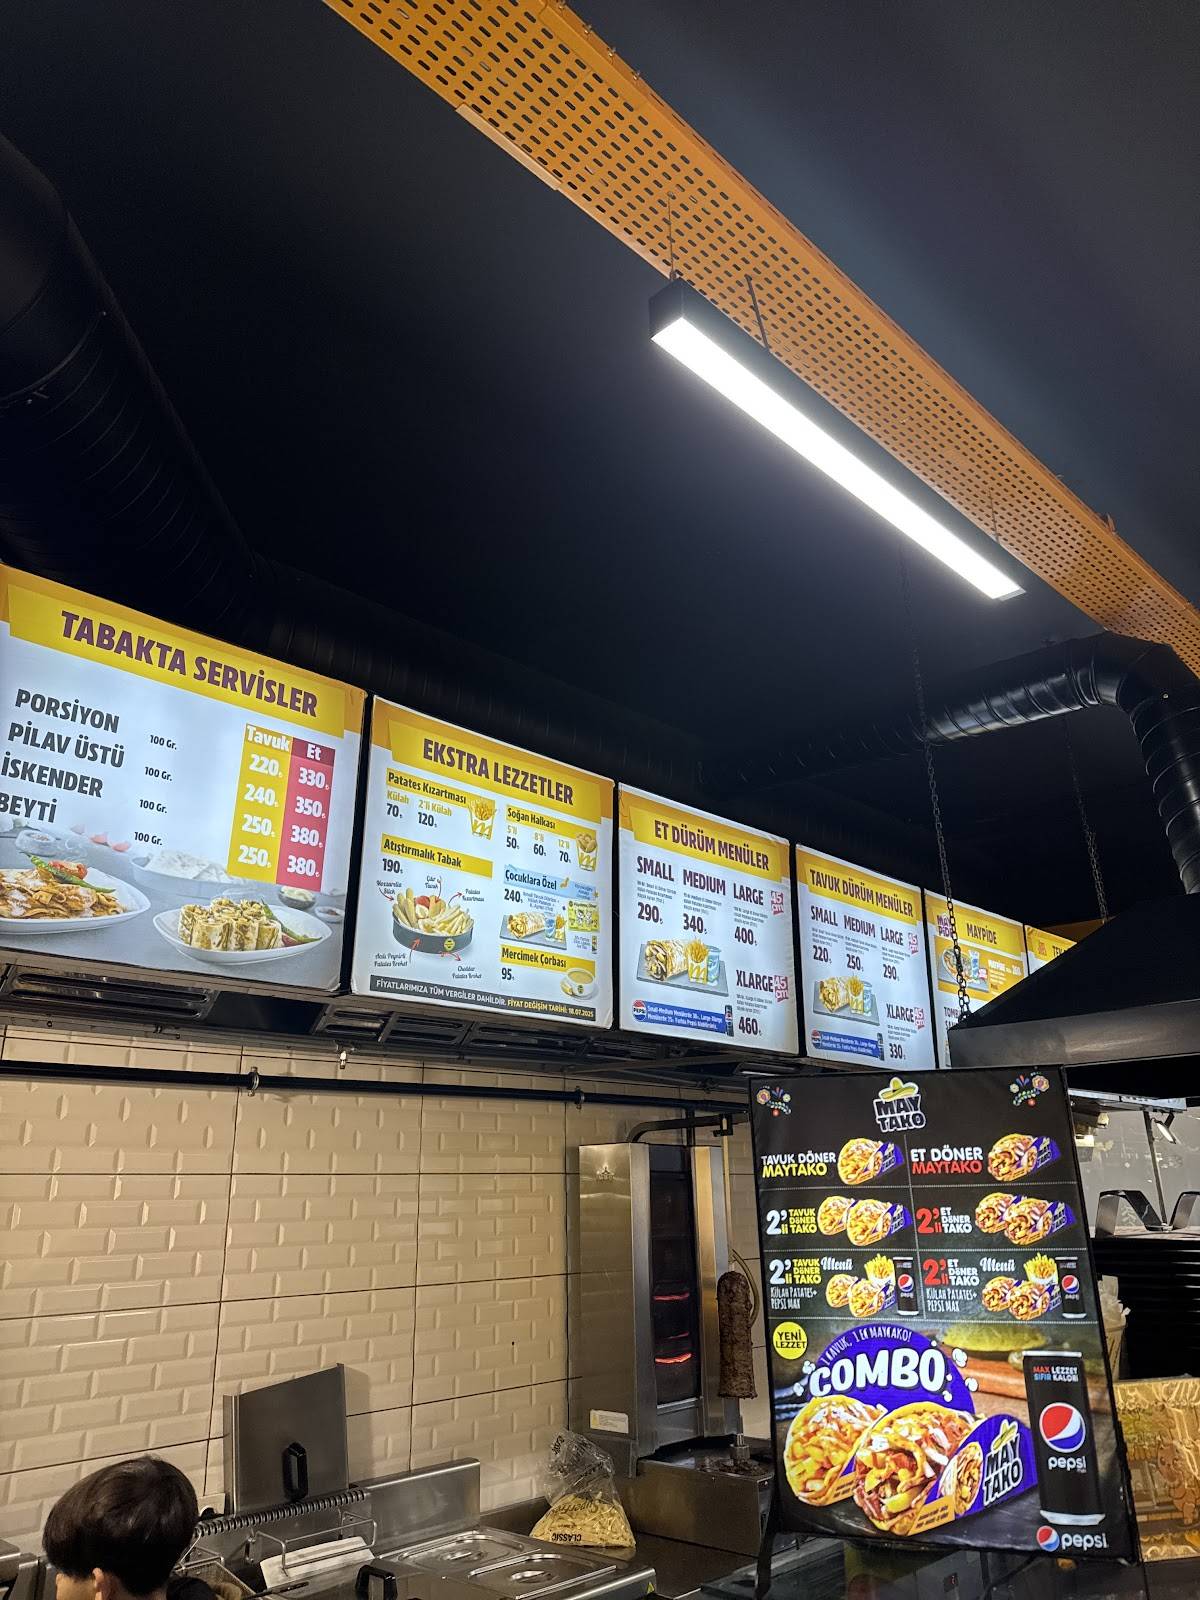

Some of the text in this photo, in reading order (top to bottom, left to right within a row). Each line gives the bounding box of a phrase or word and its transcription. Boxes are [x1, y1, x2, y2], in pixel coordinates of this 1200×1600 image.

[61, 610, 319, 718] TABAKTA SERVİSLER
[15, 688, 120, 733] PORSİYON
[8, 721, 125, 768] PİLAV ÜSTÜ
[150, 734, 178, 750] 100 Gr.
[246, 725, 291, 752] Tavuk
[306, 743, 322, 761] Et
[0, 751, 104, 798] İSKENDER
[145, 766, 173, 782] 100 Gr.
[423, 738, 574, 806] EKSTRA LEZZETLER
[388, 771, 467, 805] Patates Kızartması
[0, 792, 58, 823] BEYTİ
[139, 799, 168, 814] 100 Gr.
[386, 790, 410, 805] Külah
[431, 802, 452, 816] Külah
[507, 807, 556, 830] Soğan Halkası
[134, 832, 163, 846] 100 Gr.
[654, 819, 770, 872] ET DÜRÜM MENÜLER
[383, 838, 463, 868] Atıştırmalık Tabak
[505, 869, 557, 890] Çocuklara Özel
[637, 855, 674, 882] SMALL
[683, 869, 726, 896] MEDIUM
[733, 882, 764, 906] LARGE
[809, 868, 914, 917] TAVUK DÜRÜM MENÜLER
[811, 905, 838, 926] SMALL
[844, 915, 876, 938] MEDIUM
[881, 926, 904, 946] LARGE
[966, 924, 997, 945] MAYPİDE
[501, 947, 567, 968] Mercimek Çorbası
[736, 969, 774, 993] XLARGE
[376, 978, 429, 994] FİYATLARIMIZA
[429, 985, 444, 996] TÜM
[445, 989, 476, 1001] VERGİLER
[507, 998, 524, 1008] FİYAT
[524, 1001, 548, 1012] DEĞİŞİM
[886, 1003, 914, 1023] XLARGE
[944, 1006, 960, 1019] TOMB
[873, 1095, 921, 1117] MAY
[876, 1112, 926, 1133] TAKO
[760, 1150, 837, 1166] TAVUK DÖNER
[910, 1149, 927, 1162] ET
[930, 1144, 983, 1161] DÖNER
[761, 1163, 828, 1178] MAYTAKO
[912, 1160, 982, 1175] MAYTAKO
[789, 1208, 816, 1217] TAVUK
[940, 1207, 952, 1216] ET
[789, 1224, 818, 1234] TAKO
[942, 1223, 973, 1234] TAKO
[793, 1259, 820, 1267] TAVUK
[820, 1256, 853, 1271] Menü
[948, 1259, 959, 1268] ET
[980, 1257, 1016, 1272] Menü
[793, 1274, 822, 1285] TAKO
[949, 1275, 980, 1286] TAKO
[775, 1340, 806, 1349] LEZZET
[777, 1329, 802, 1341] YENİ
[809, 1348, 945, 1397] COMBO
[1033, 1365, 1078, 1375] MAX LEZZET
[985, 1437, 1021, 1478] MAY
[1048, 1456, 1086, 1471] pepsi
[982, 1458, 1023, 1507] TAKO
[551, 1533, 582, 1542] CLASSIC
[1061, 1533, 1108, 1551] pepsi
